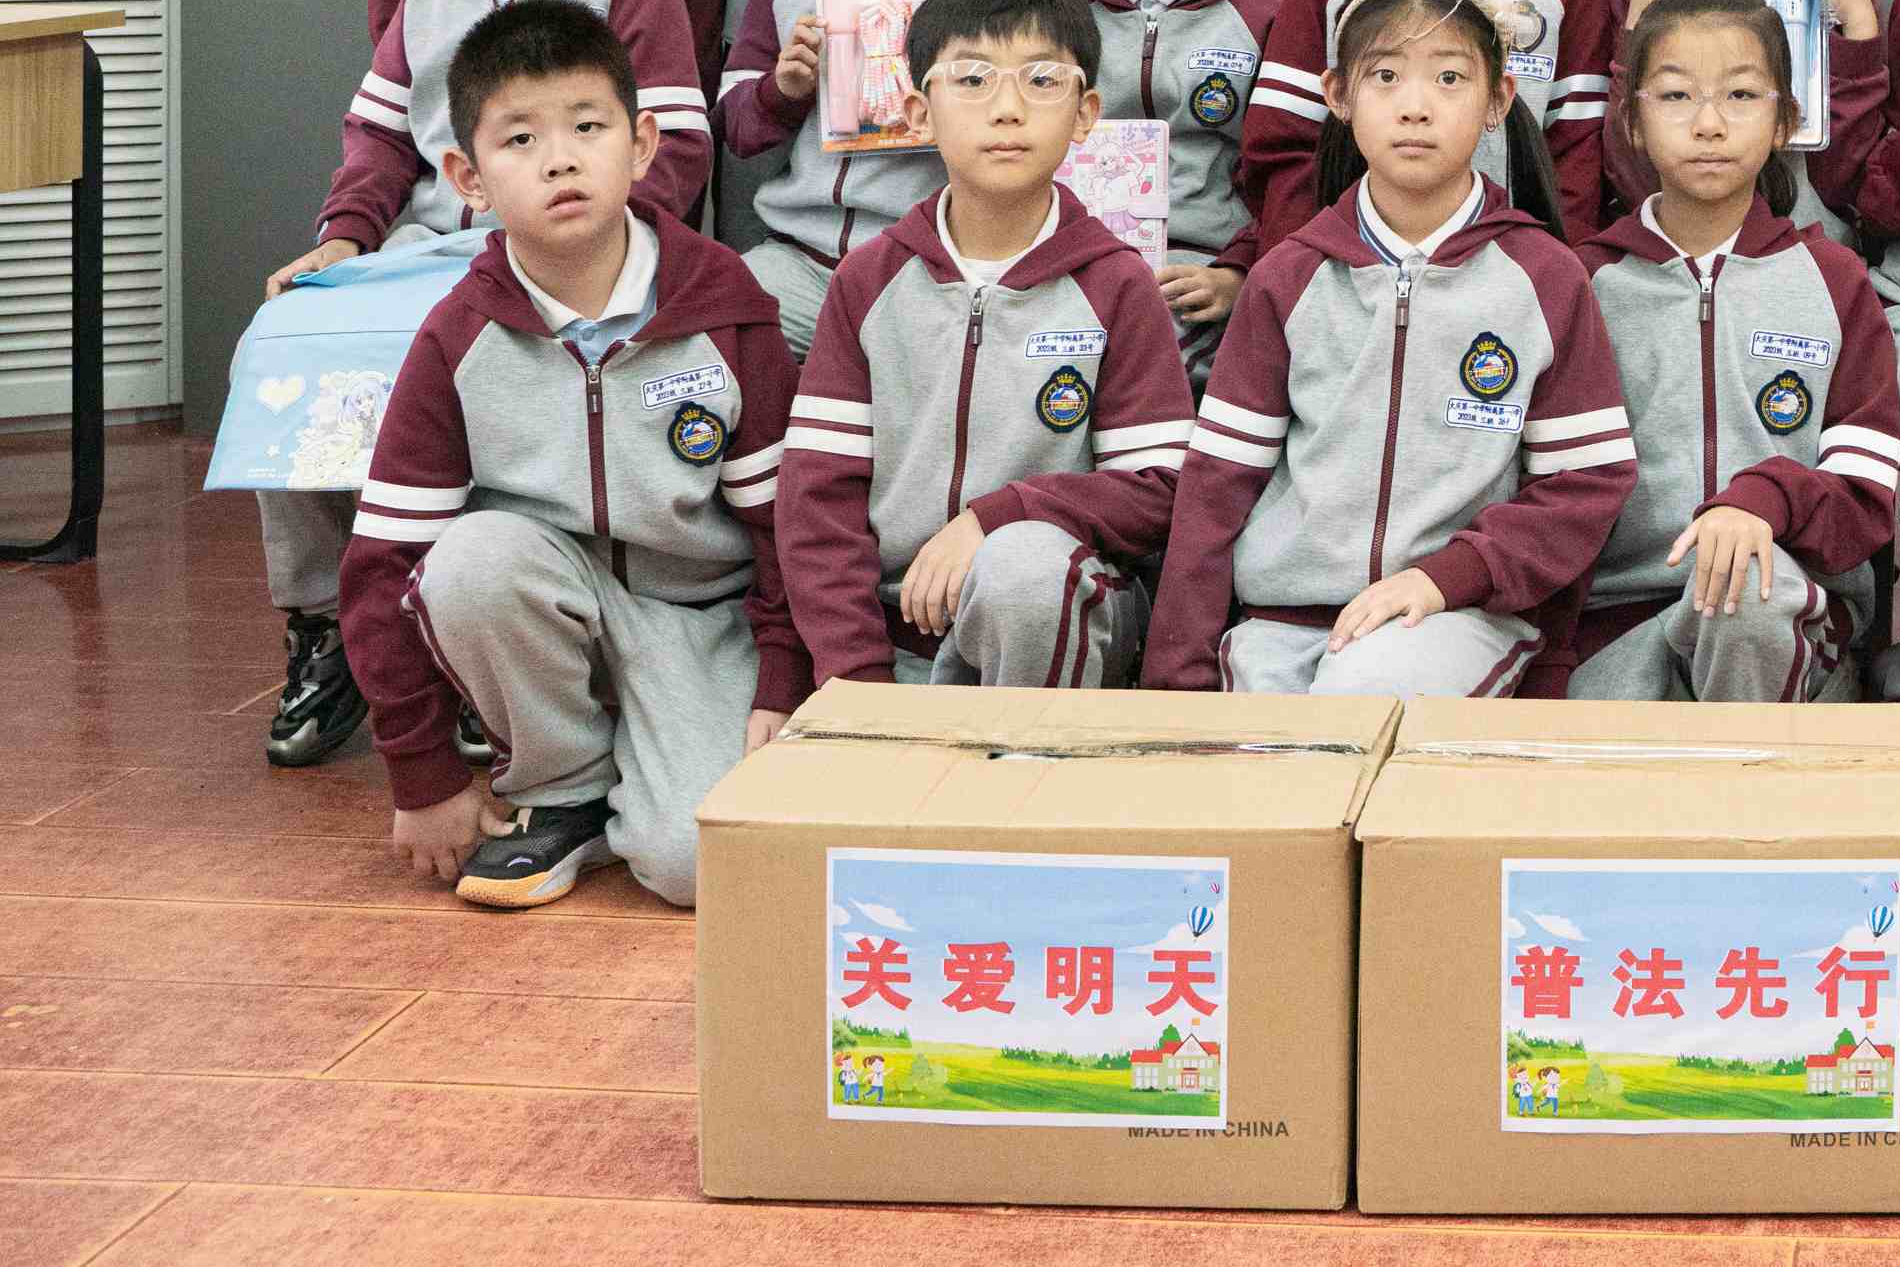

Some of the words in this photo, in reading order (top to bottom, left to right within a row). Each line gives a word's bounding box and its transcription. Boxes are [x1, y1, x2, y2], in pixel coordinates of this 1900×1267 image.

[841, 937, 1218, 1016] 关爱明天
[1511, 946, 1890, 1019] 普法先行
[1128, 1127, 1189, 1138] MADE
[1222, 1121, 1289, 1137] CHINA
[1790, 1132, 1850, 1148] MADE
[1857, 1132, 1878, 1147] IN
